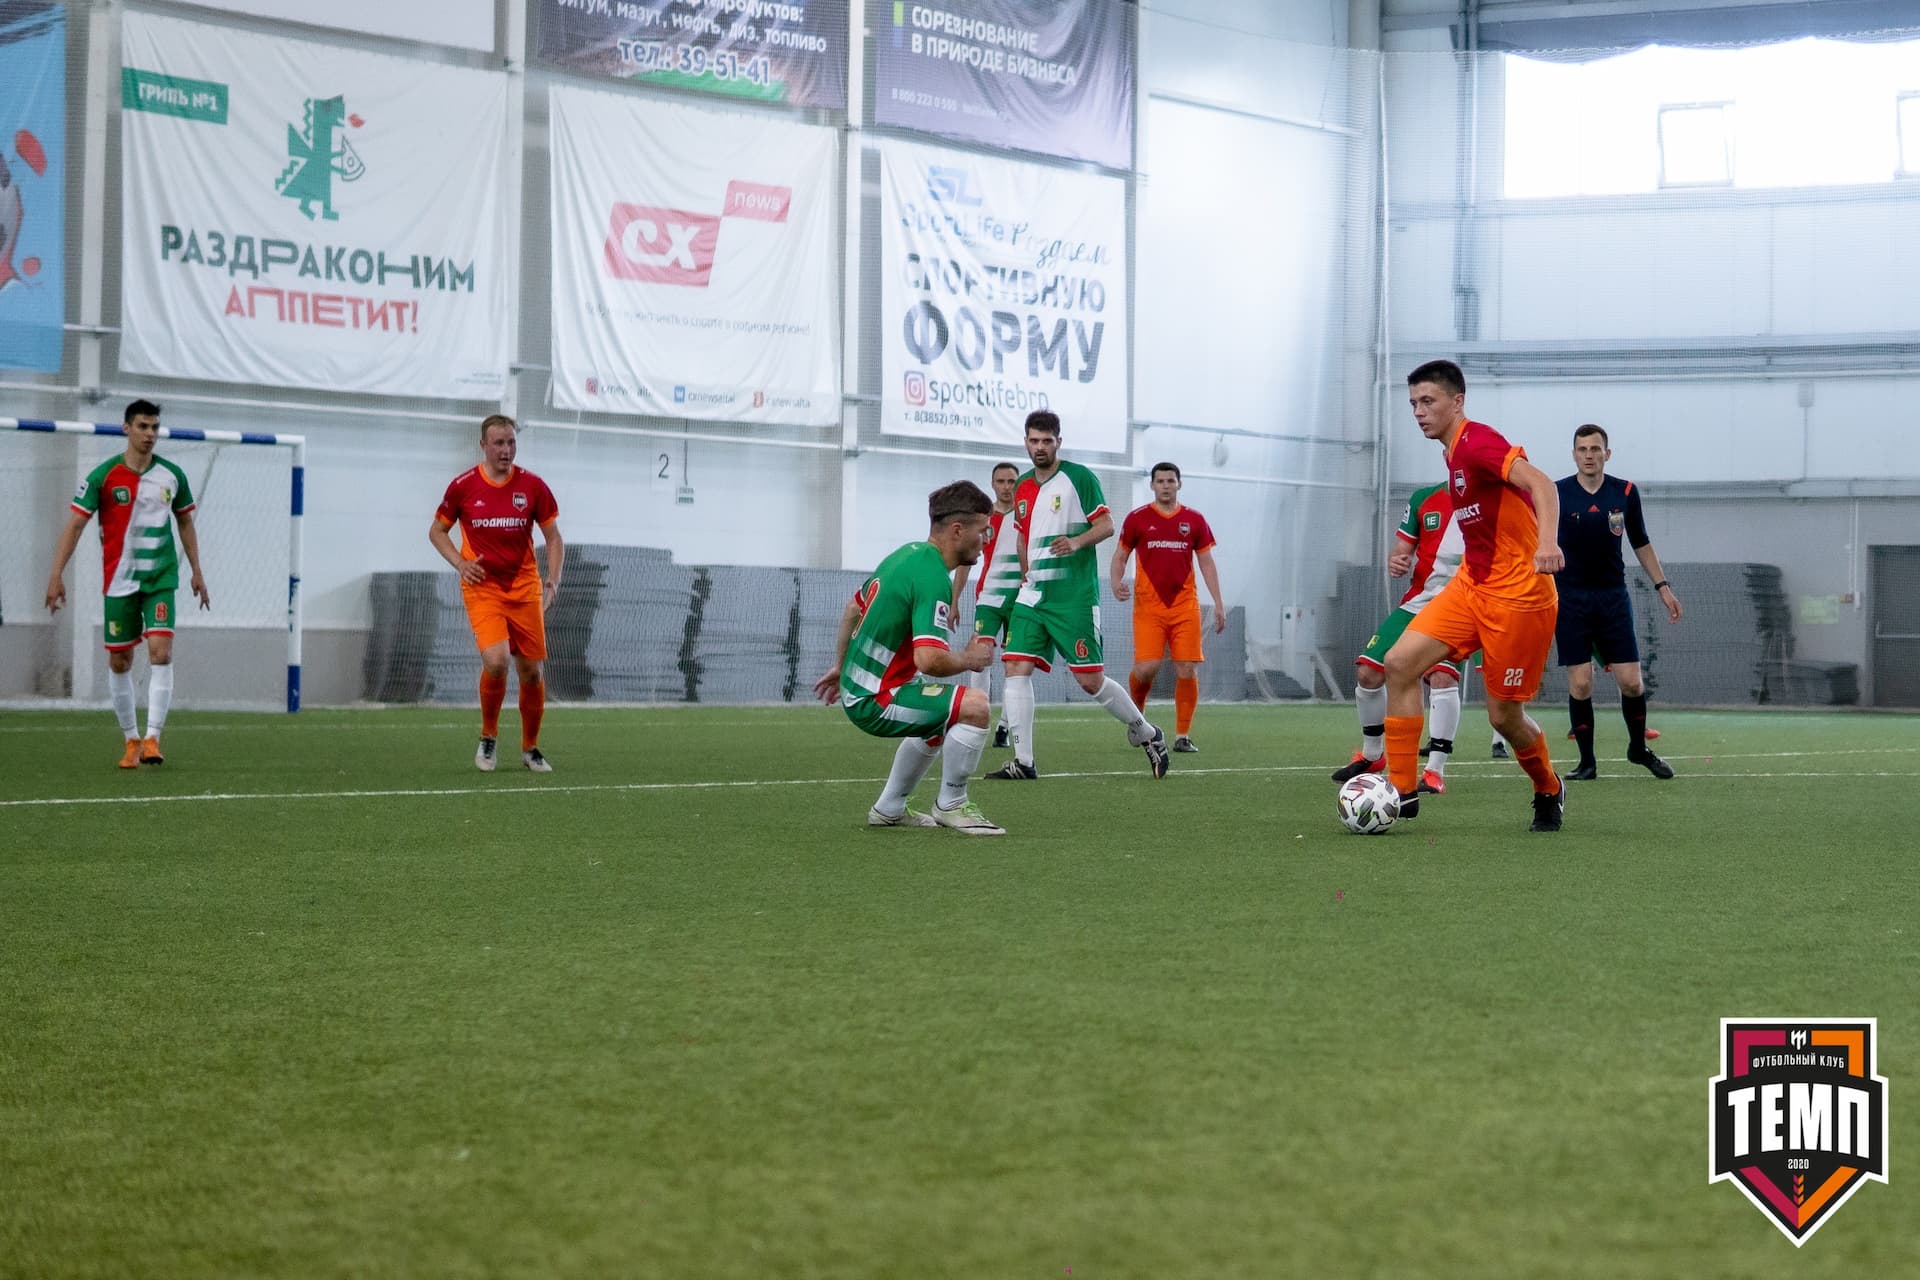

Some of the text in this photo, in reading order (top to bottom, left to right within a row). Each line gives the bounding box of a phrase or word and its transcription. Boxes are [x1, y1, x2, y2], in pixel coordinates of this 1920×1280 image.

[617, 2, 664, 28] мазут,
[672, 13, 724, 39] нефть,
[729, 22, 760, 42] диз.
[763, 29, 827, 52] топливо
[911, 5, 1039, 53] СОРЕВНОВАНИЕ
[678, 44, 770, 86] 39-51-41
[911, 33, 1076, 87] В ПРИРОДЕ БИЗНЕСА
[138, 81, 218, 113] ГРИЛЬ №1
[160, 224, 475, 293] РАЗДРАКОНИМ
[225, 284, 419, 335] АППЕТИТ!
[903, 300, 1105, 384] ФОРМУ
[914, 410, 949, 426] 8(3852)
[658, 453, 669, 479] 2
[1074, 639, 1089, 658] 6
[1503, 668, 1524, 687] 22
